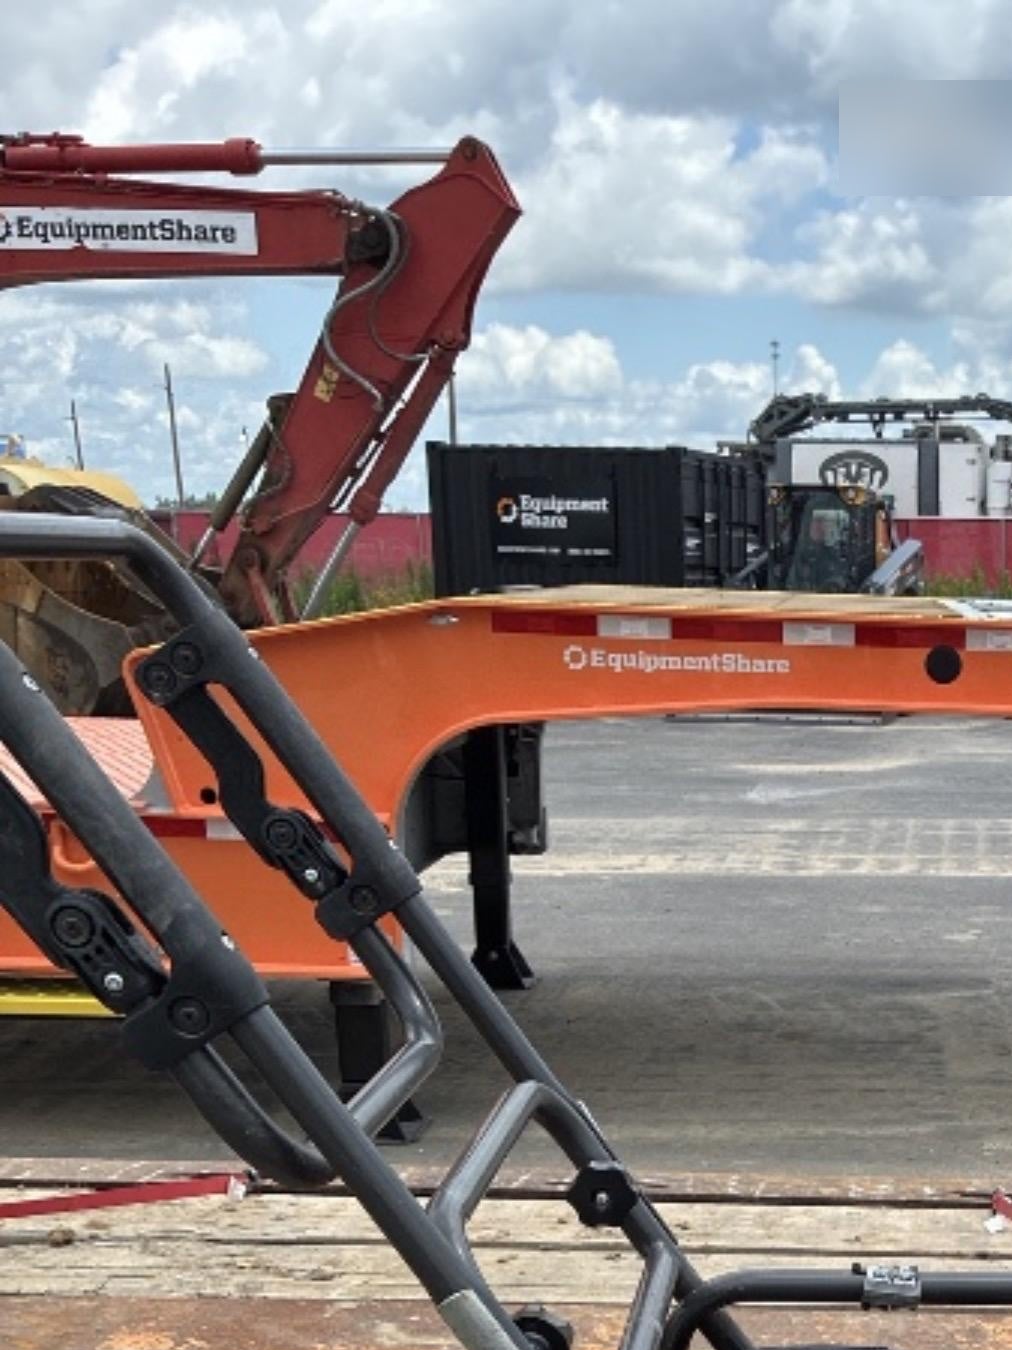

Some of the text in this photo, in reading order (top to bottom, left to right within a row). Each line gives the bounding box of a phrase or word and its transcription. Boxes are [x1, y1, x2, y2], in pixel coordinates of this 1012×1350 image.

[16, 215, 237, 244] EquipmentShare
[519, 494, 609, 513] Equipment
[521, 512, 568, 529] Share
[590, 648, 791, 673] EquipmentShare
